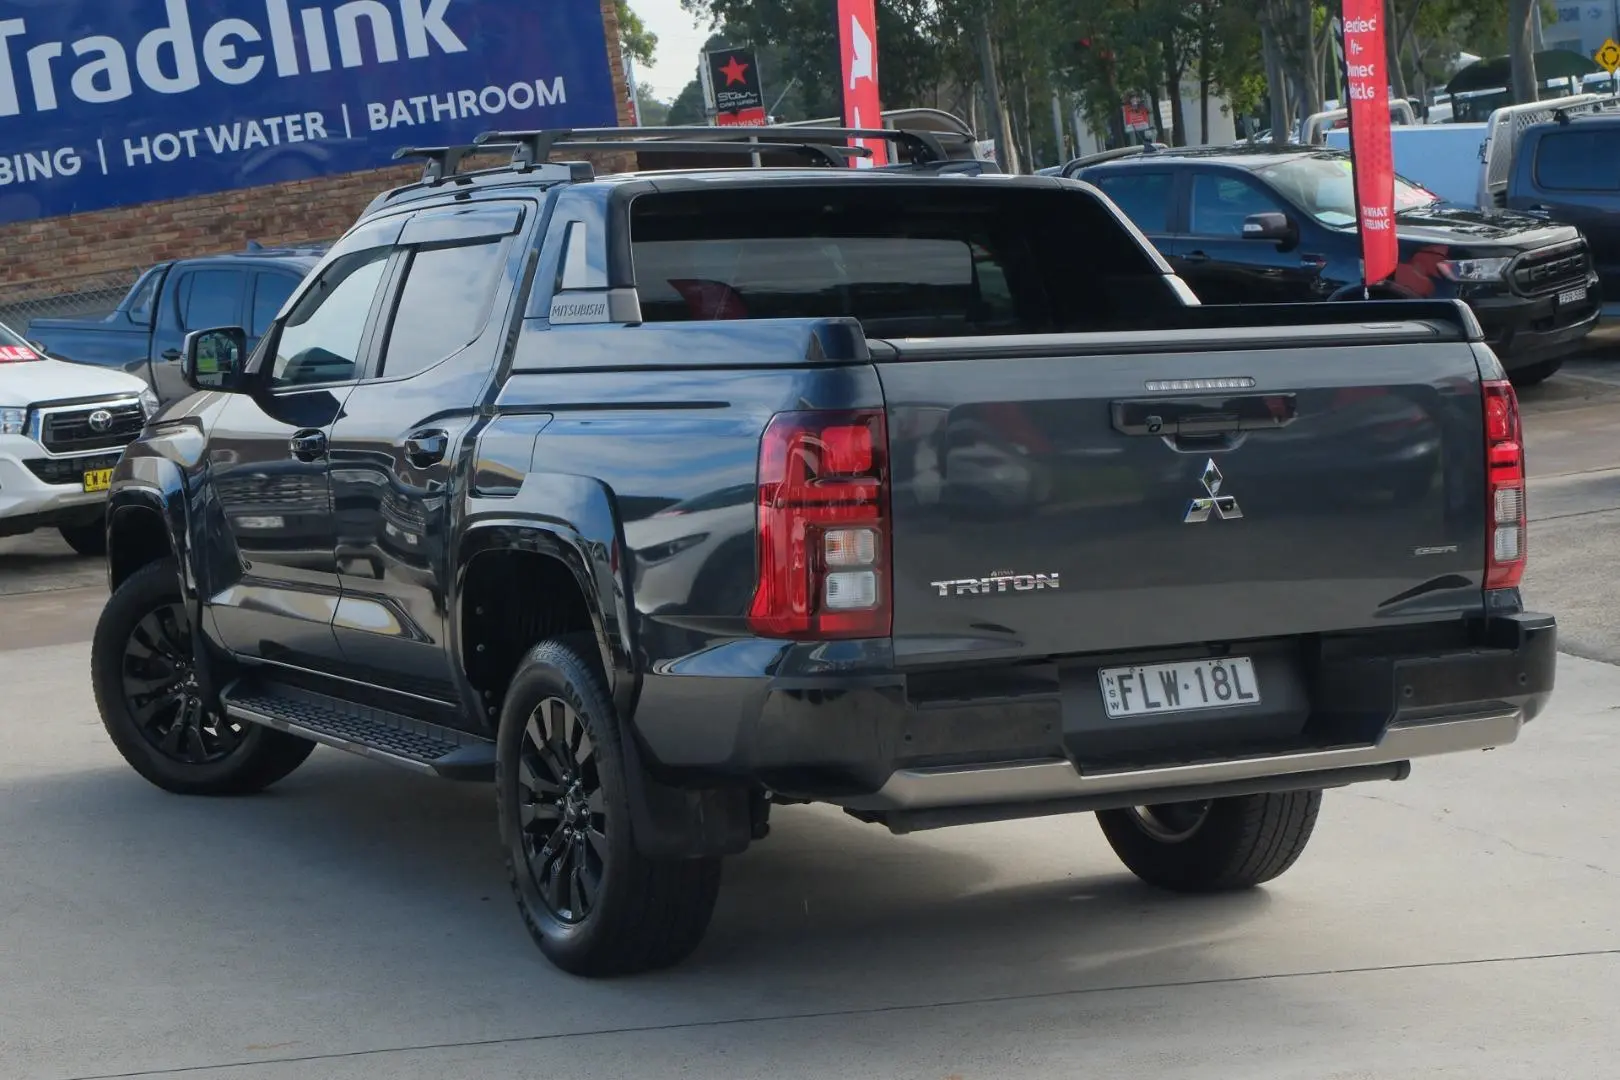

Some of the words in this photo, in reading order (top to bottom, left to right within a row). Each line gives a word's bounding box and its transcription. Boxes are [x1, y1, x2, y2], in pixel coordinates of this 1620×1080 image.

[0, 0, 468, 117] Tradelink
[123, 129, 200, 167] HOT
[204, 112, 328, 154] WATER
[367, 76, 567, 132] BATHROOM
[552, 303, 605, 317] MITSUBISHI
[930, 572, 1060, 596] TRITON
